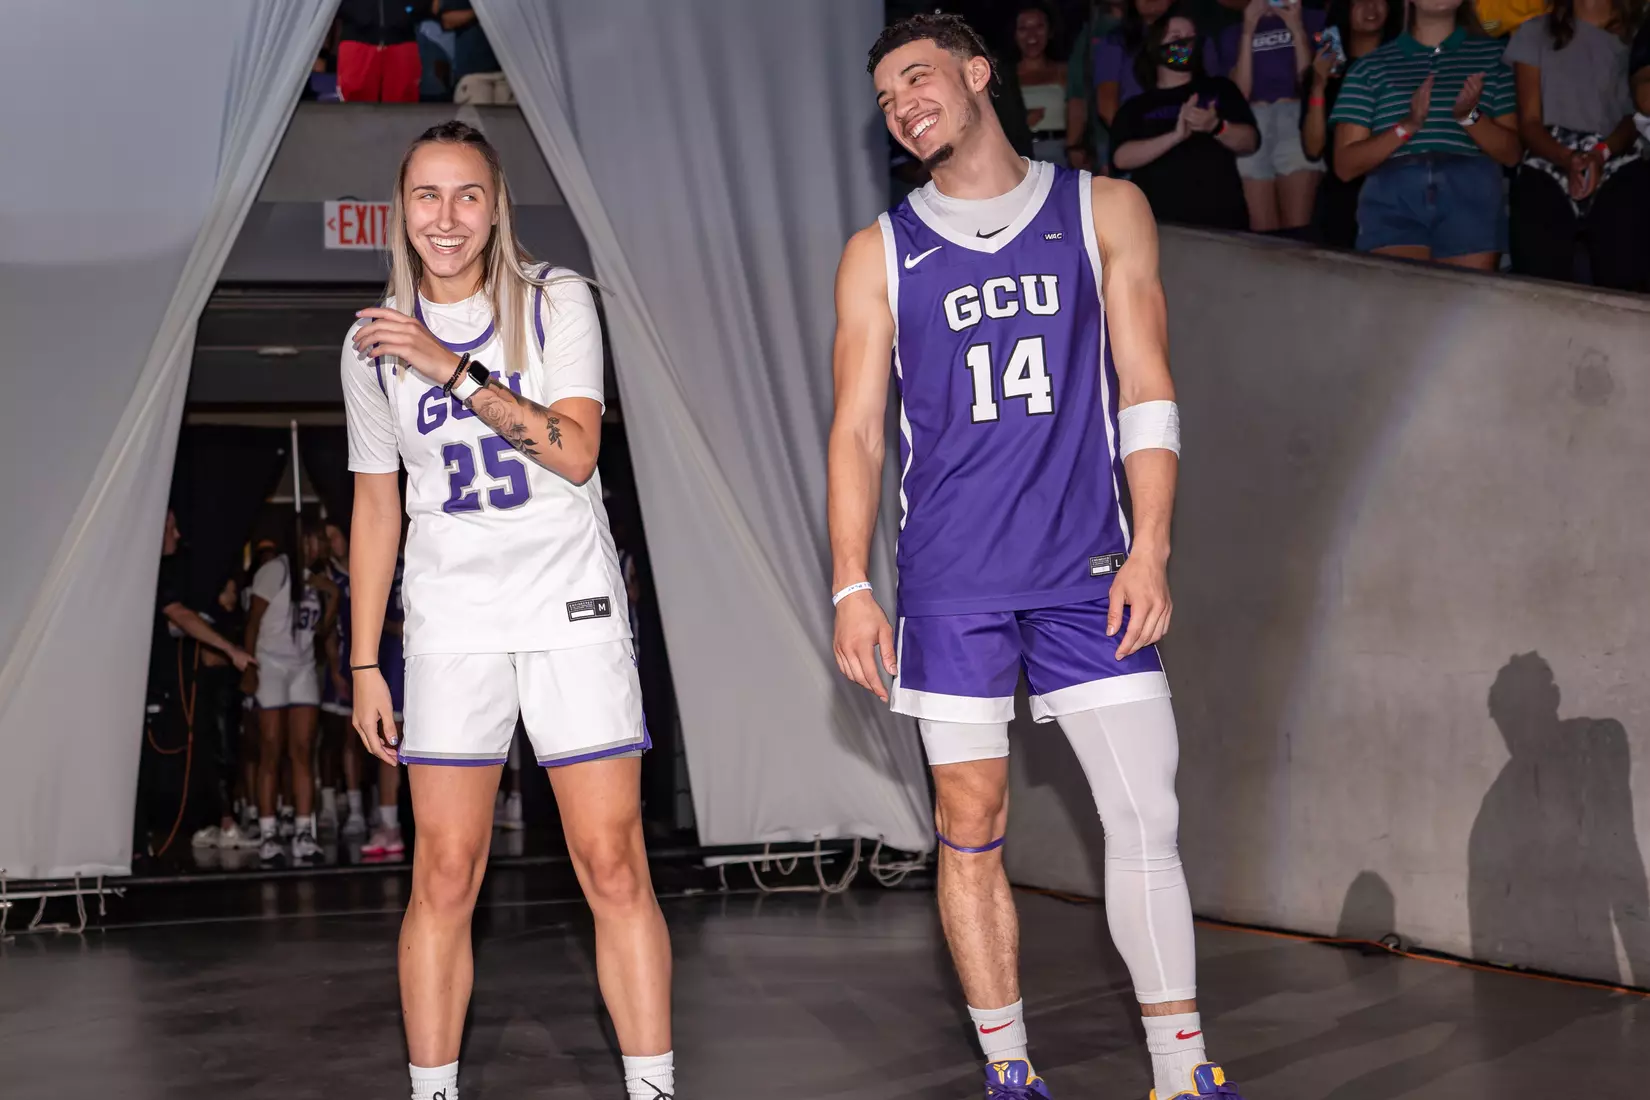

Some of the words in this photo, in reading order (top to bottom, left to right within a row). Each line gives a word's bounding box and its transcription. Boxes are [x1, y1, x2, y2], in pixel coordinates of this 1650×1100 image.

[338, 204, 390, 246] EXIT
[1044, 232, 1062, 240] WAC
[943, 274, 1061, 333] GCU
[964, 334, 1055, 424] 14
[440, 434, 533, 515] 25
[598, 603, 606, 611] M
